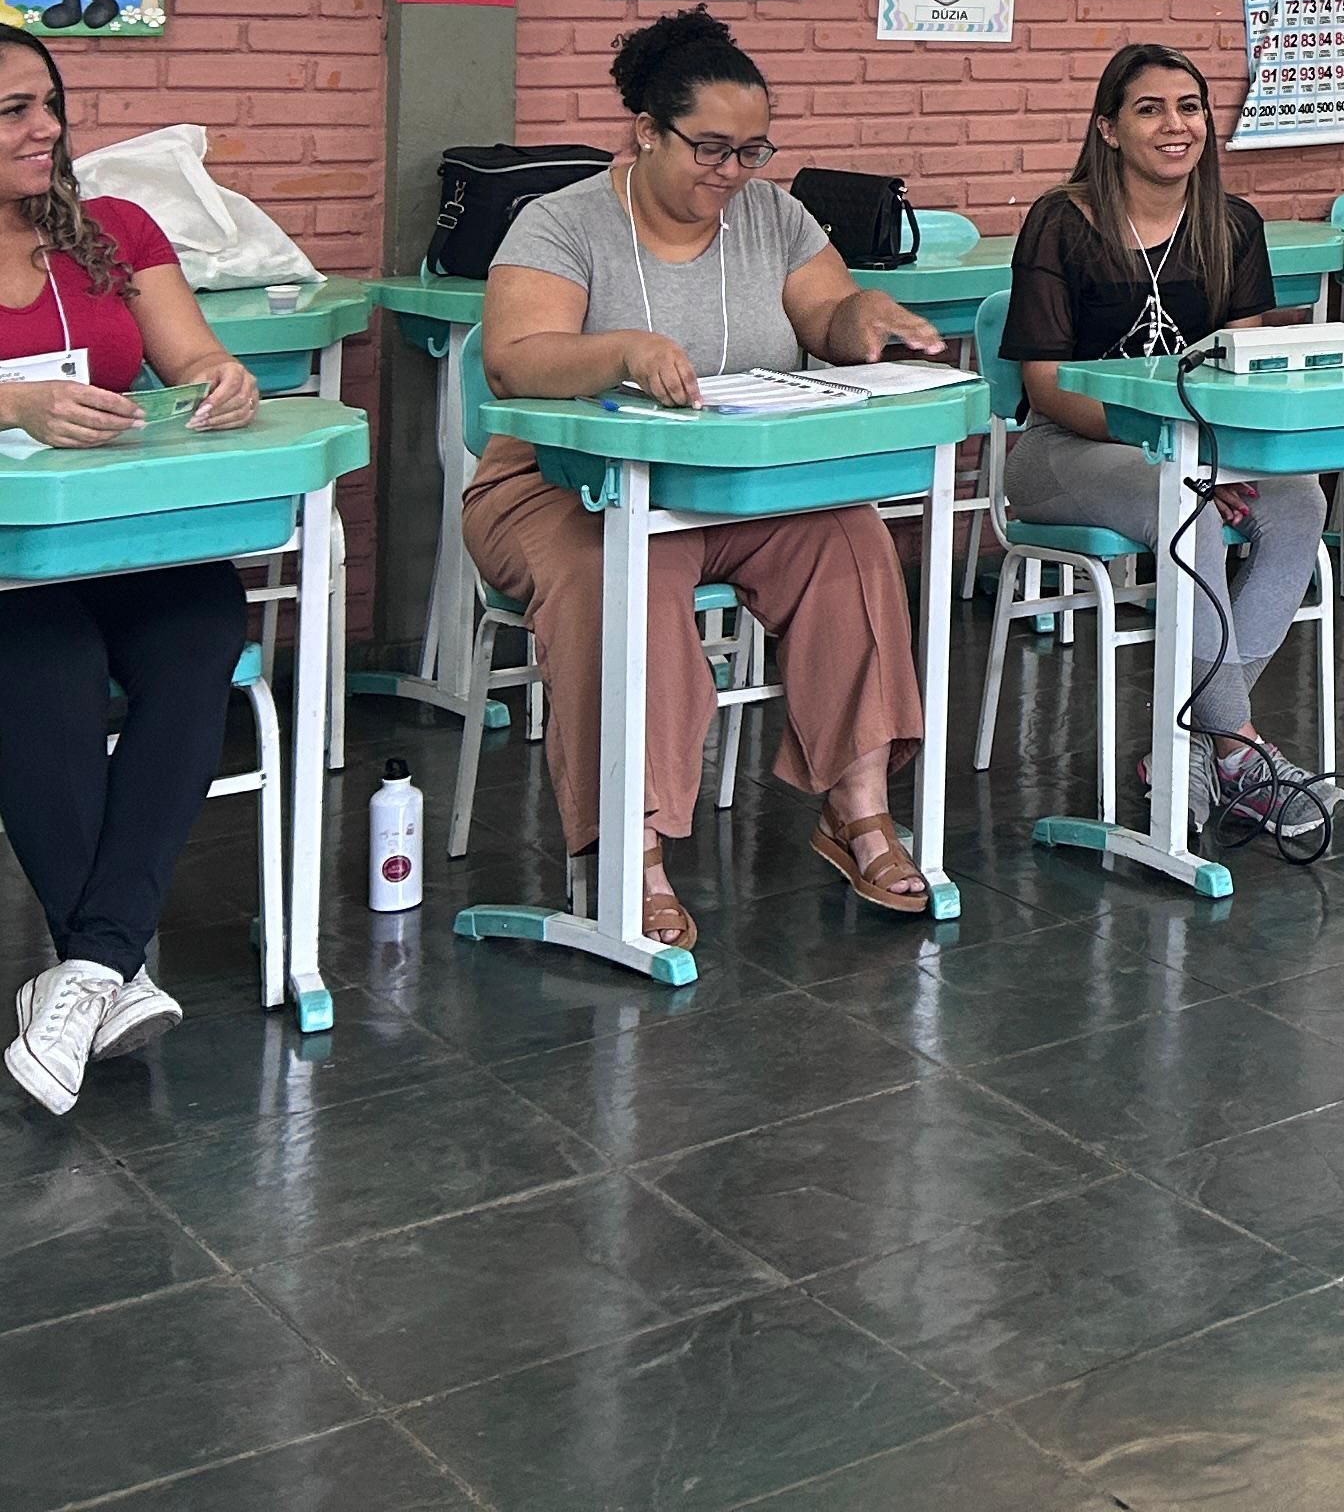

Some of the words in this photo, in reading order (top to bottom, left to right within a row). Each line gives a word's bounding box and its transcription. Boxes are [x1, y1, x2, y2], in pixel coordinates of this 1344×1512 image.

[932, 8, 968, 21] DÚZIA
[1250, 10, 1269, 25] 70
[1260, 105, 1276, 117] 200
[1278, 104, 1296, 115] 300
[1298, 103, 1315, 114] 400
[1317, 102, 1334, 112] 500
